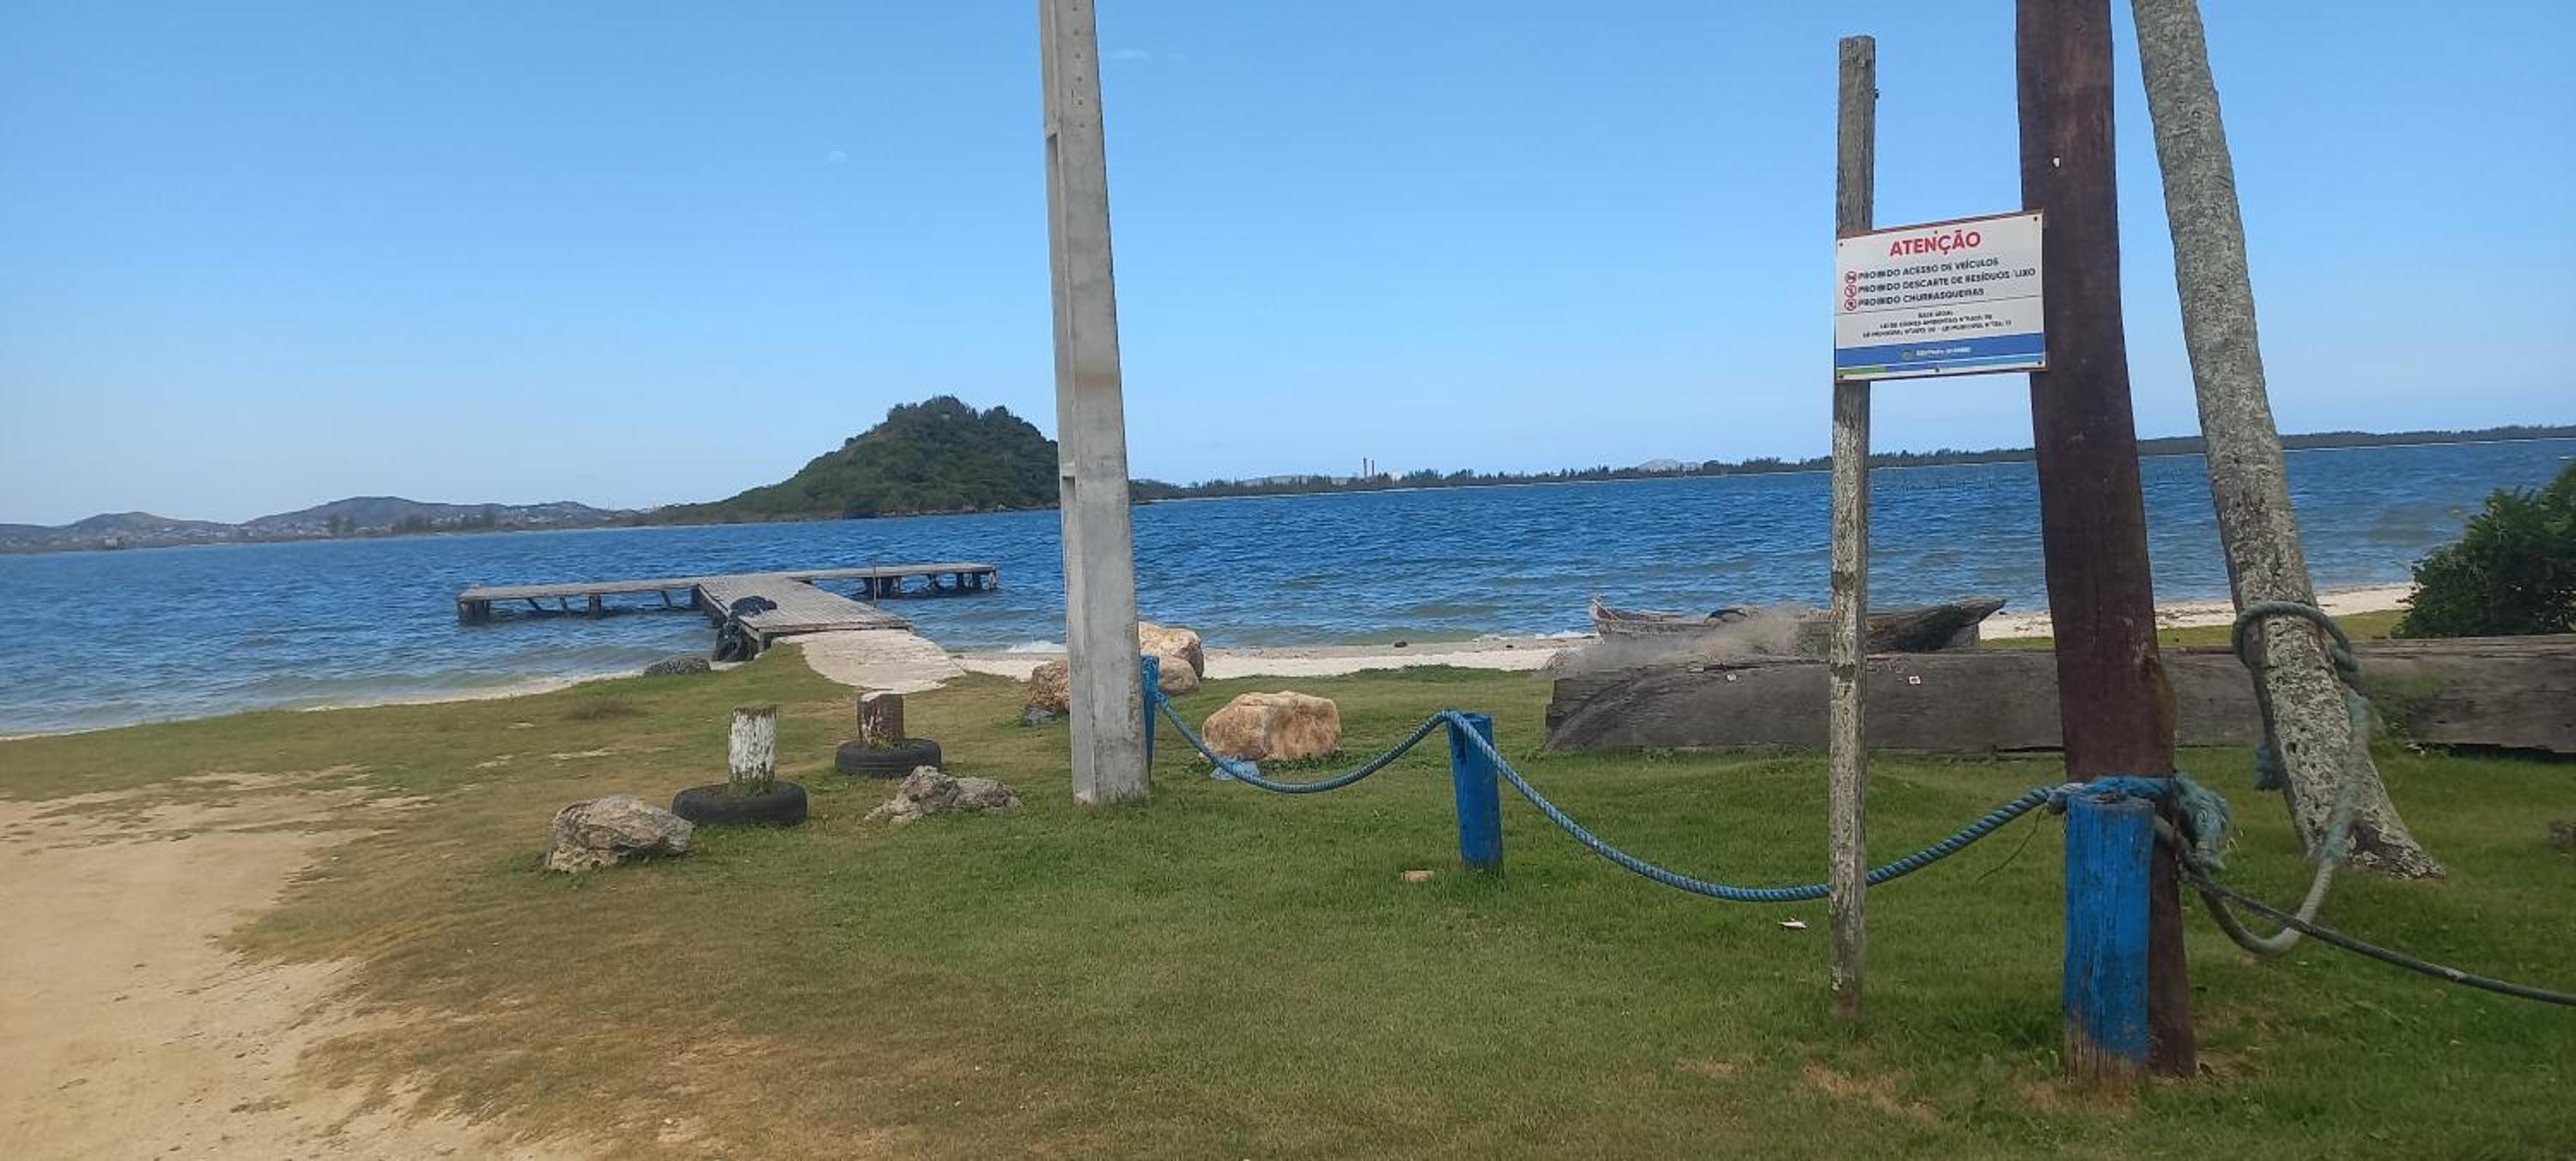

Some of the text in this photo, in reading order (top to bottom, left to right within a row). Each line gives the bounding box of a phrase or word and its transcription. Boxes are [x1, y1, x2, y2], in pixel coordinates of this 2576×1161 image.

[1890, 229, 1981, 256] ATENÇÃO
[1857, 269, 1900, 279] PROIBIDO
[1902, 264, 1939, 276] ACESSO
[1941, 263, 1953, 272] DE
[1857, 283, 1900, 293] PROIBIDO
[1902, 277, 1949, 289] DESCARTE
[1950, 276, 1964, 284] DE
[1857, 288, 1984, 307] PROIBIDO CHURRASQUEIRAS
